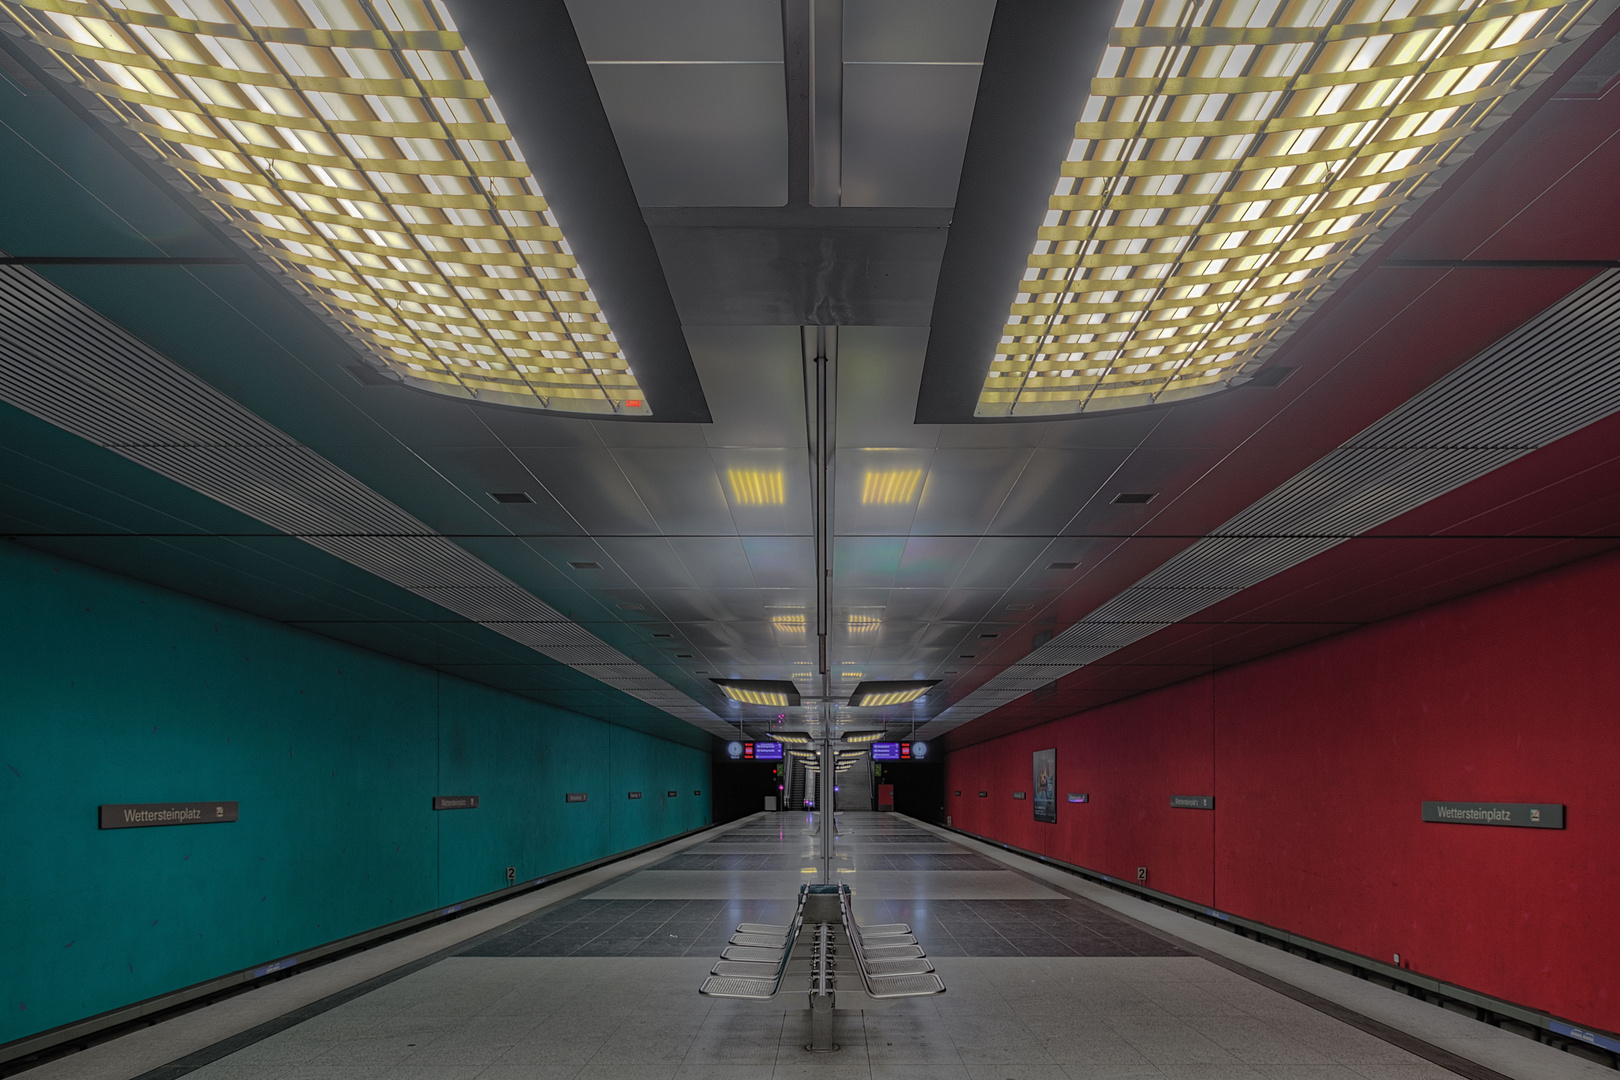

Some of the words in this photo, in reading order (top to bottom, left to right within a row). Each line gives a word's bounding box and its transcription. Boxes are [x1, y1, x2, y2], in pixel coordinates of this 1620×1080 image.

[124, 808, 201, 822] Wettersteinplatz
[1437, 806, 1511, 822] Wettersteinplatz
[508, 868, 515, 878] 2
[1138, 868, 1145, 879] 2
